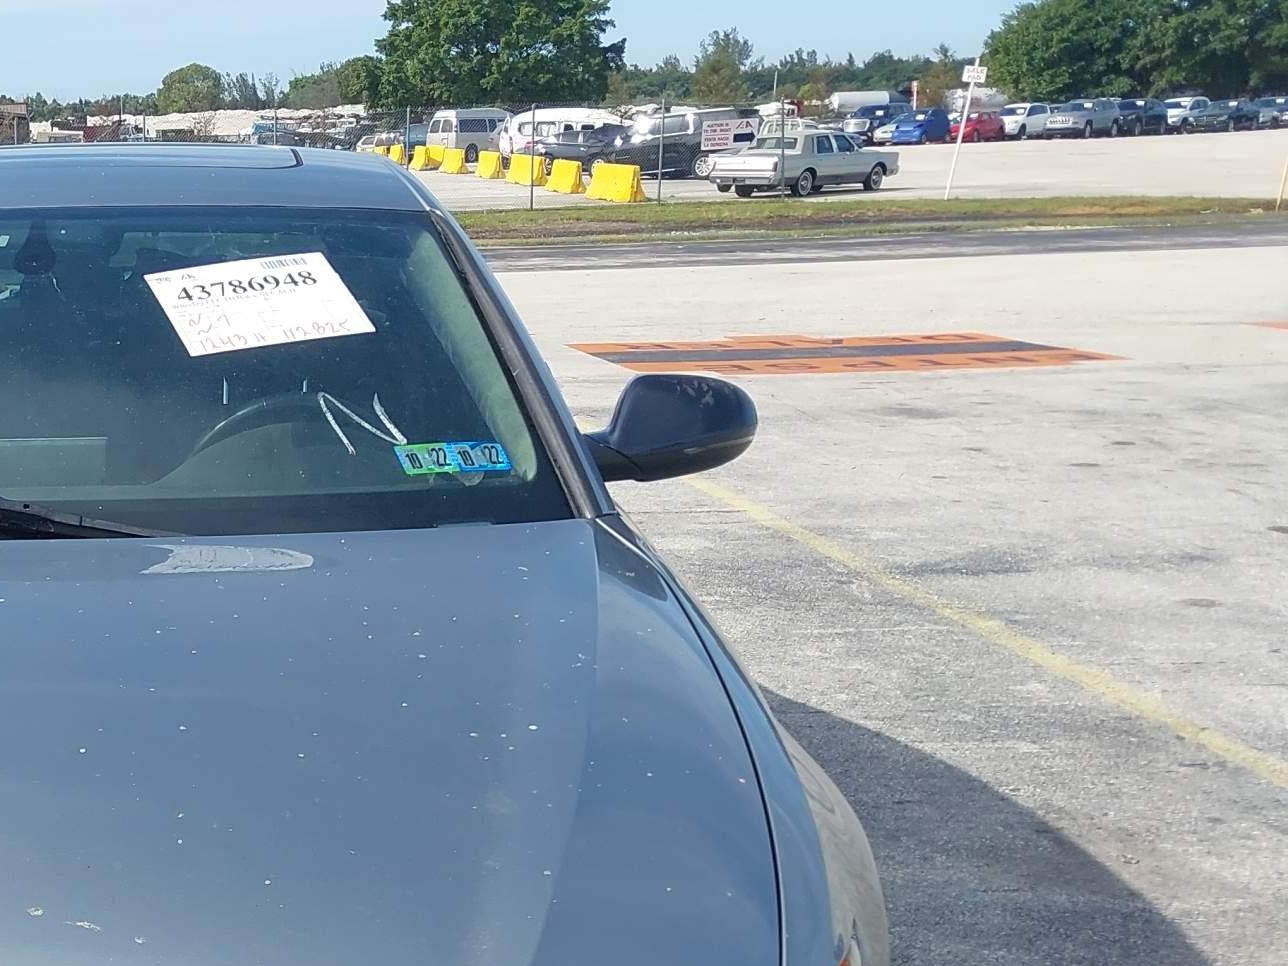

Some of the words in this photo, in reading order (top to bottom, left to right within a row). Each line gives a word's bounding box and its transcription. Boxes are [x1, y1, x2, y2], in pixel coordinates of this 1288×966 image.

[177, 270, 318, 302] 43786948
[429, 447, 453, 467] 22
[481, 445, 505, 465] 22
